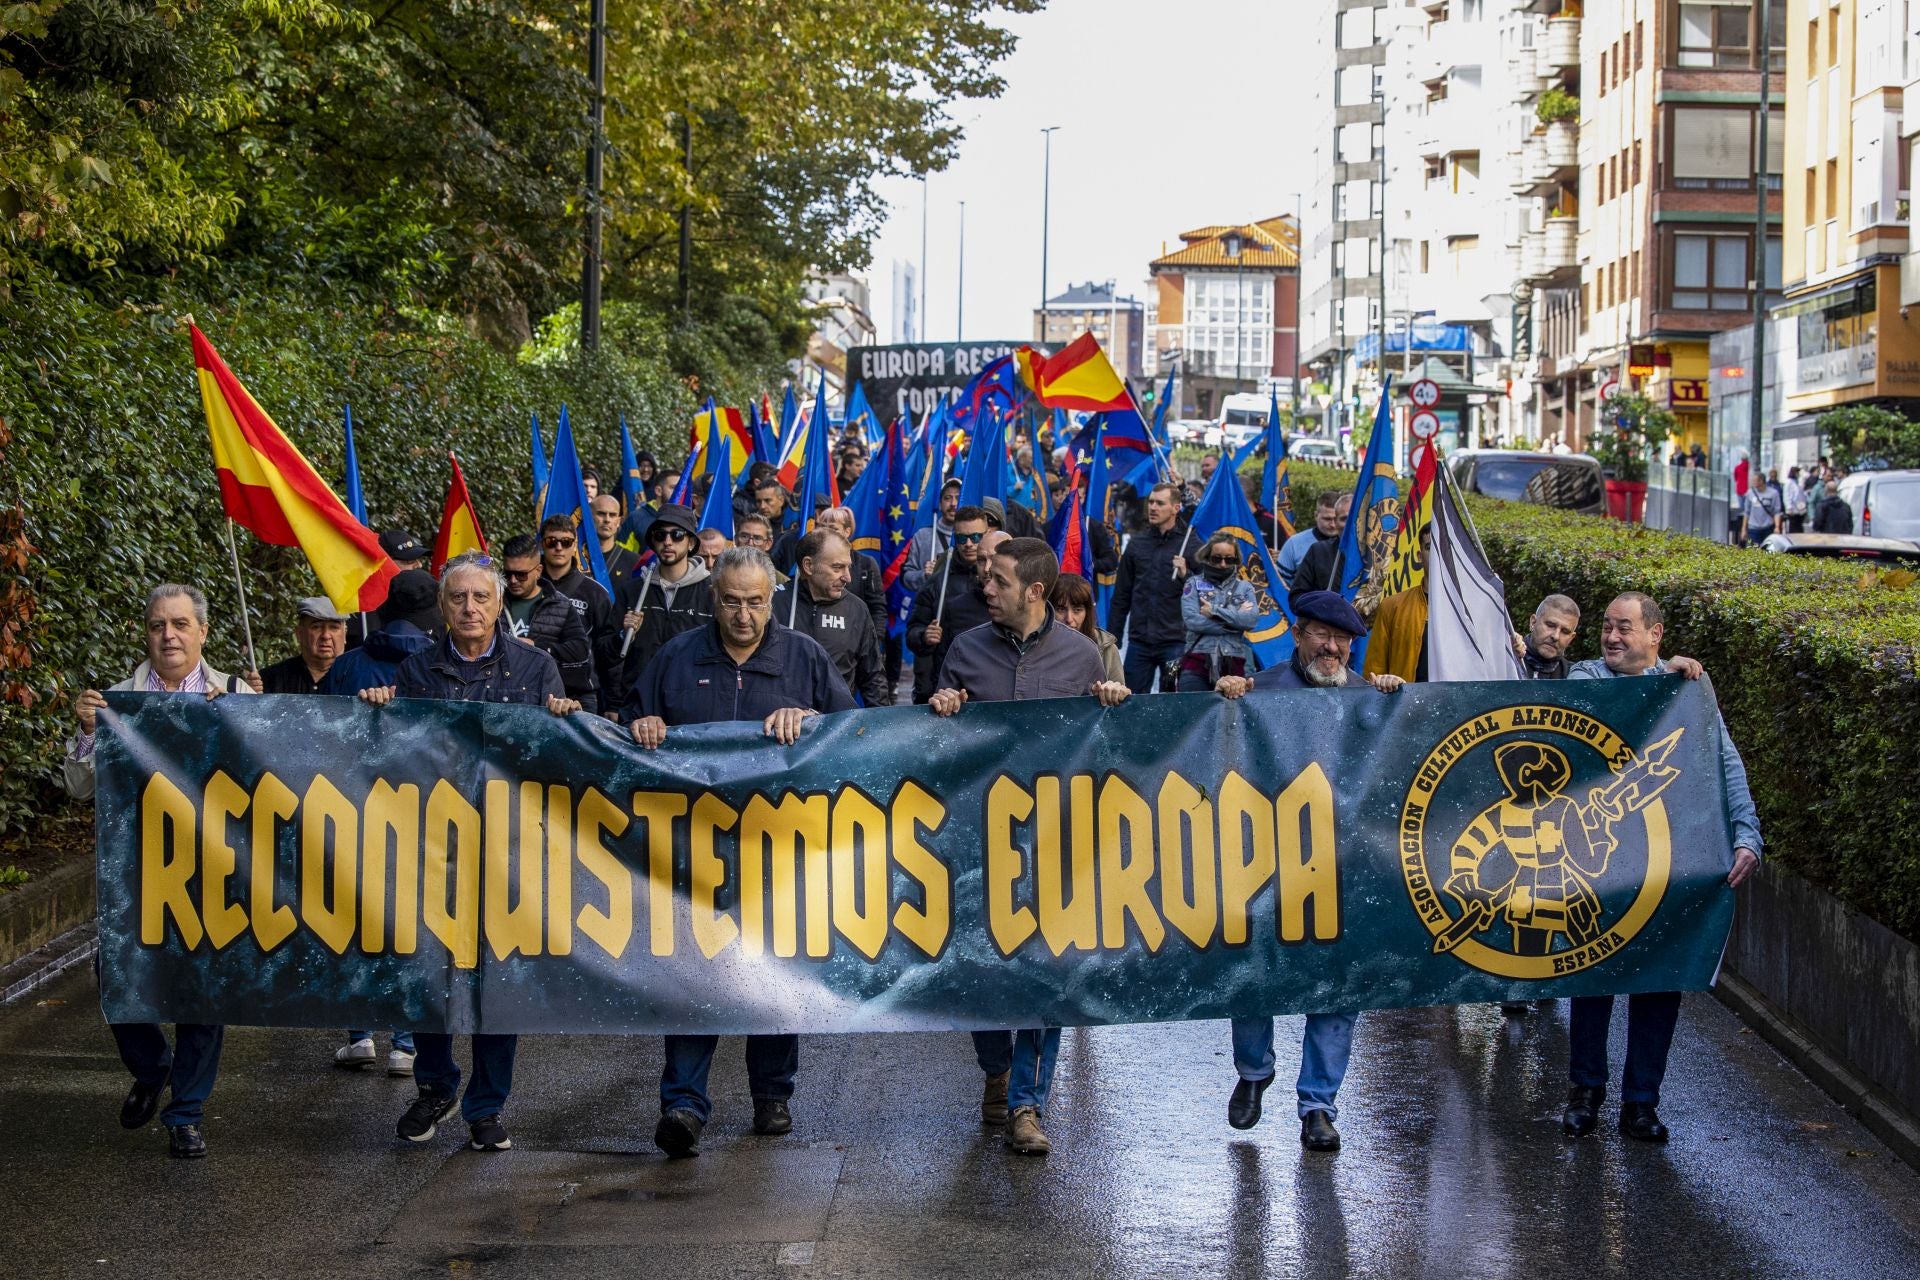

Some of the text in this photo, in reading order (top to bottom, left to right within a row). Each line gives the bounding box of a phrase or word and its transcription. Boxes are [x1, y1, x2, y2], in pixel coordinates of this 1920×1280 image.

[862, 348, 945, 379] EUROPA
[822, 613, 845, 629] HH
[140, 761, 1339, 969] RECONQUISTEMOS EUROPA
[1404, 708, 1612, 924] ASOCIACION CULTURAL ALFONSO I
